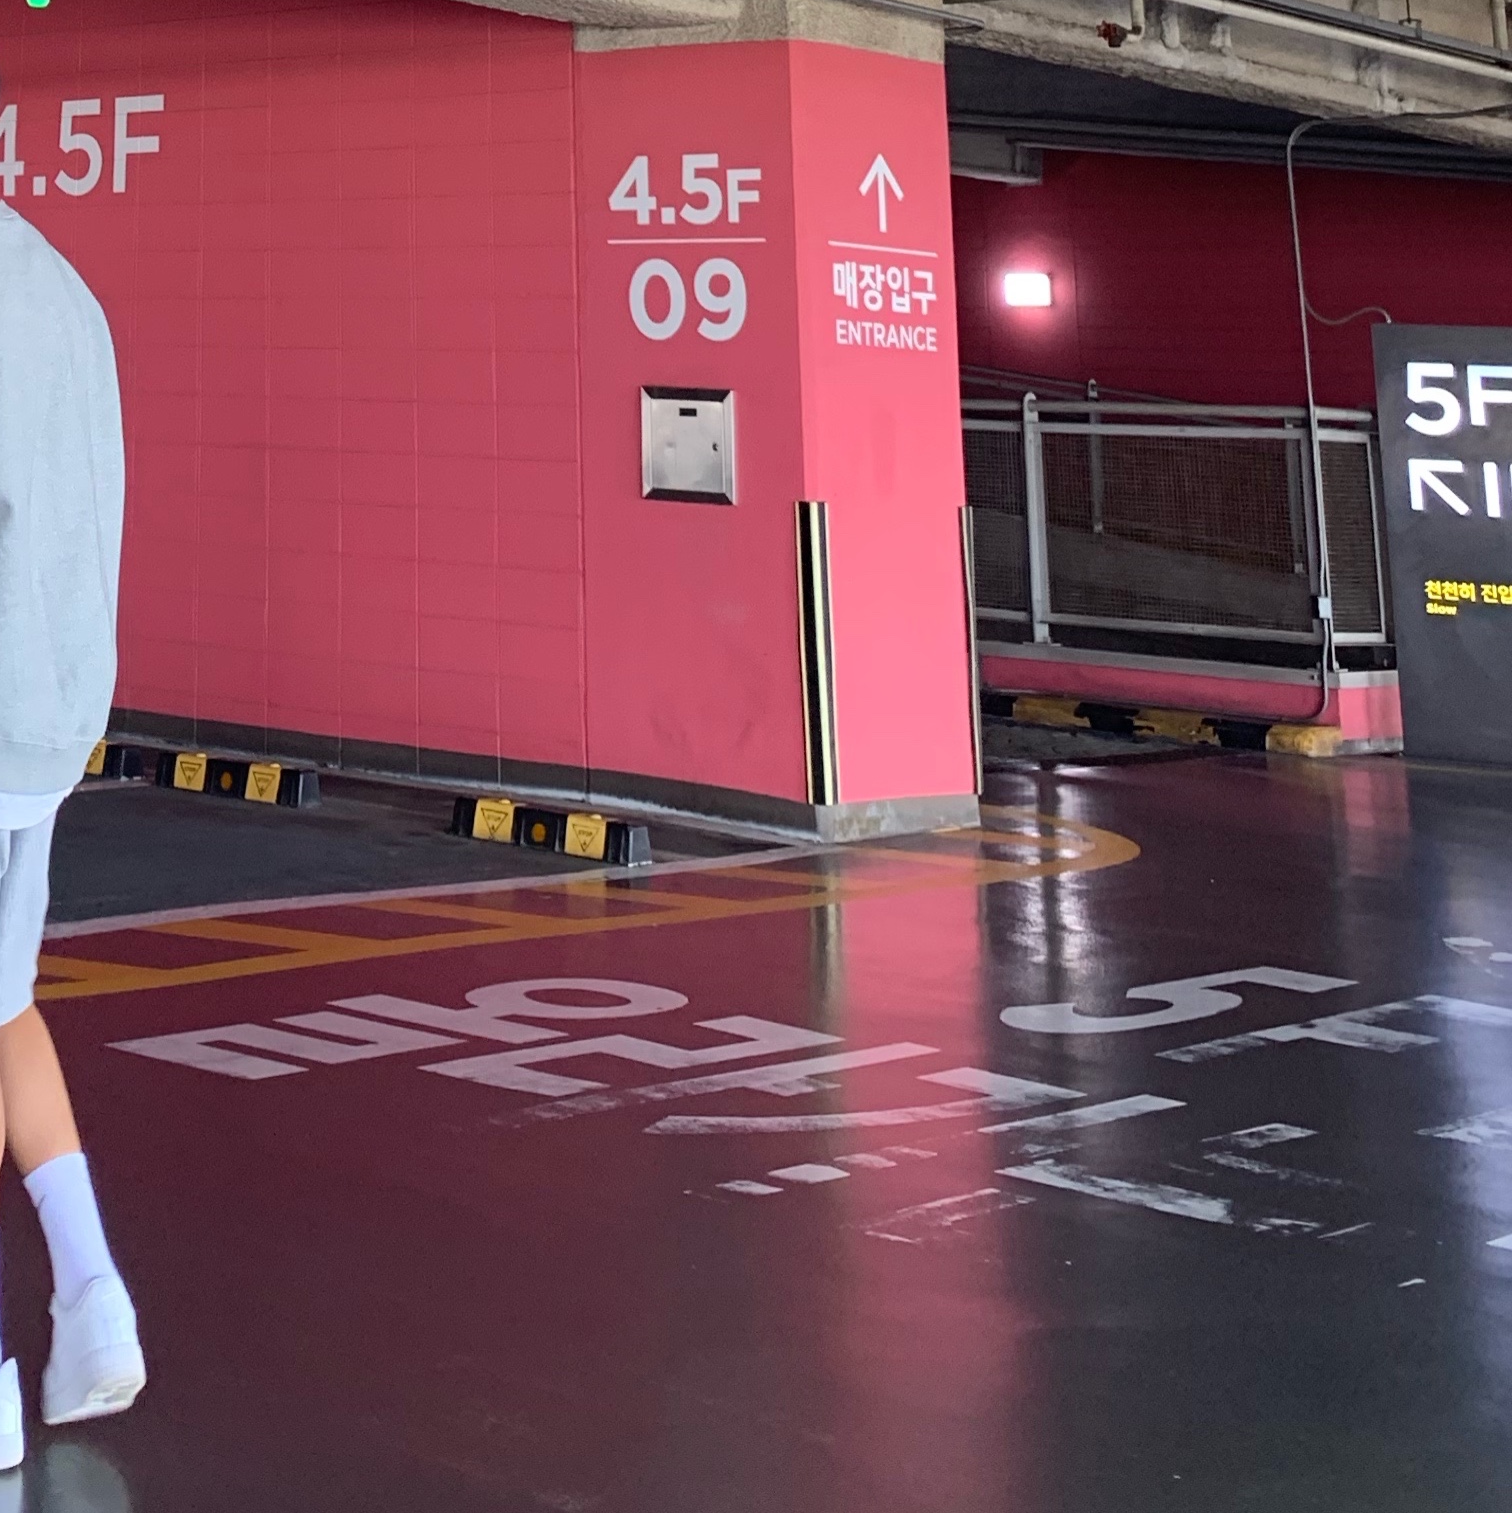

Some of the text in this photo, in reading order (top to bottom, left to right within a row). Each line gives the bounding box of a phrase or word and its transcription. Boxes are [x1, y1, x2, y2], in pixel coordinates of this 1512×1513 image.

[608, 153, 762, 225] 4.5F
[629, 258, 747, 341] 09
[832, 260, 937, 316] 매장입구
[835, 319, 938, 352] ENTRANCE
[1405, 362, 1512, 436] 5F
[1424, 580, 1476, 602] 천천히
[1426, 602, 1457, 616] Slow
